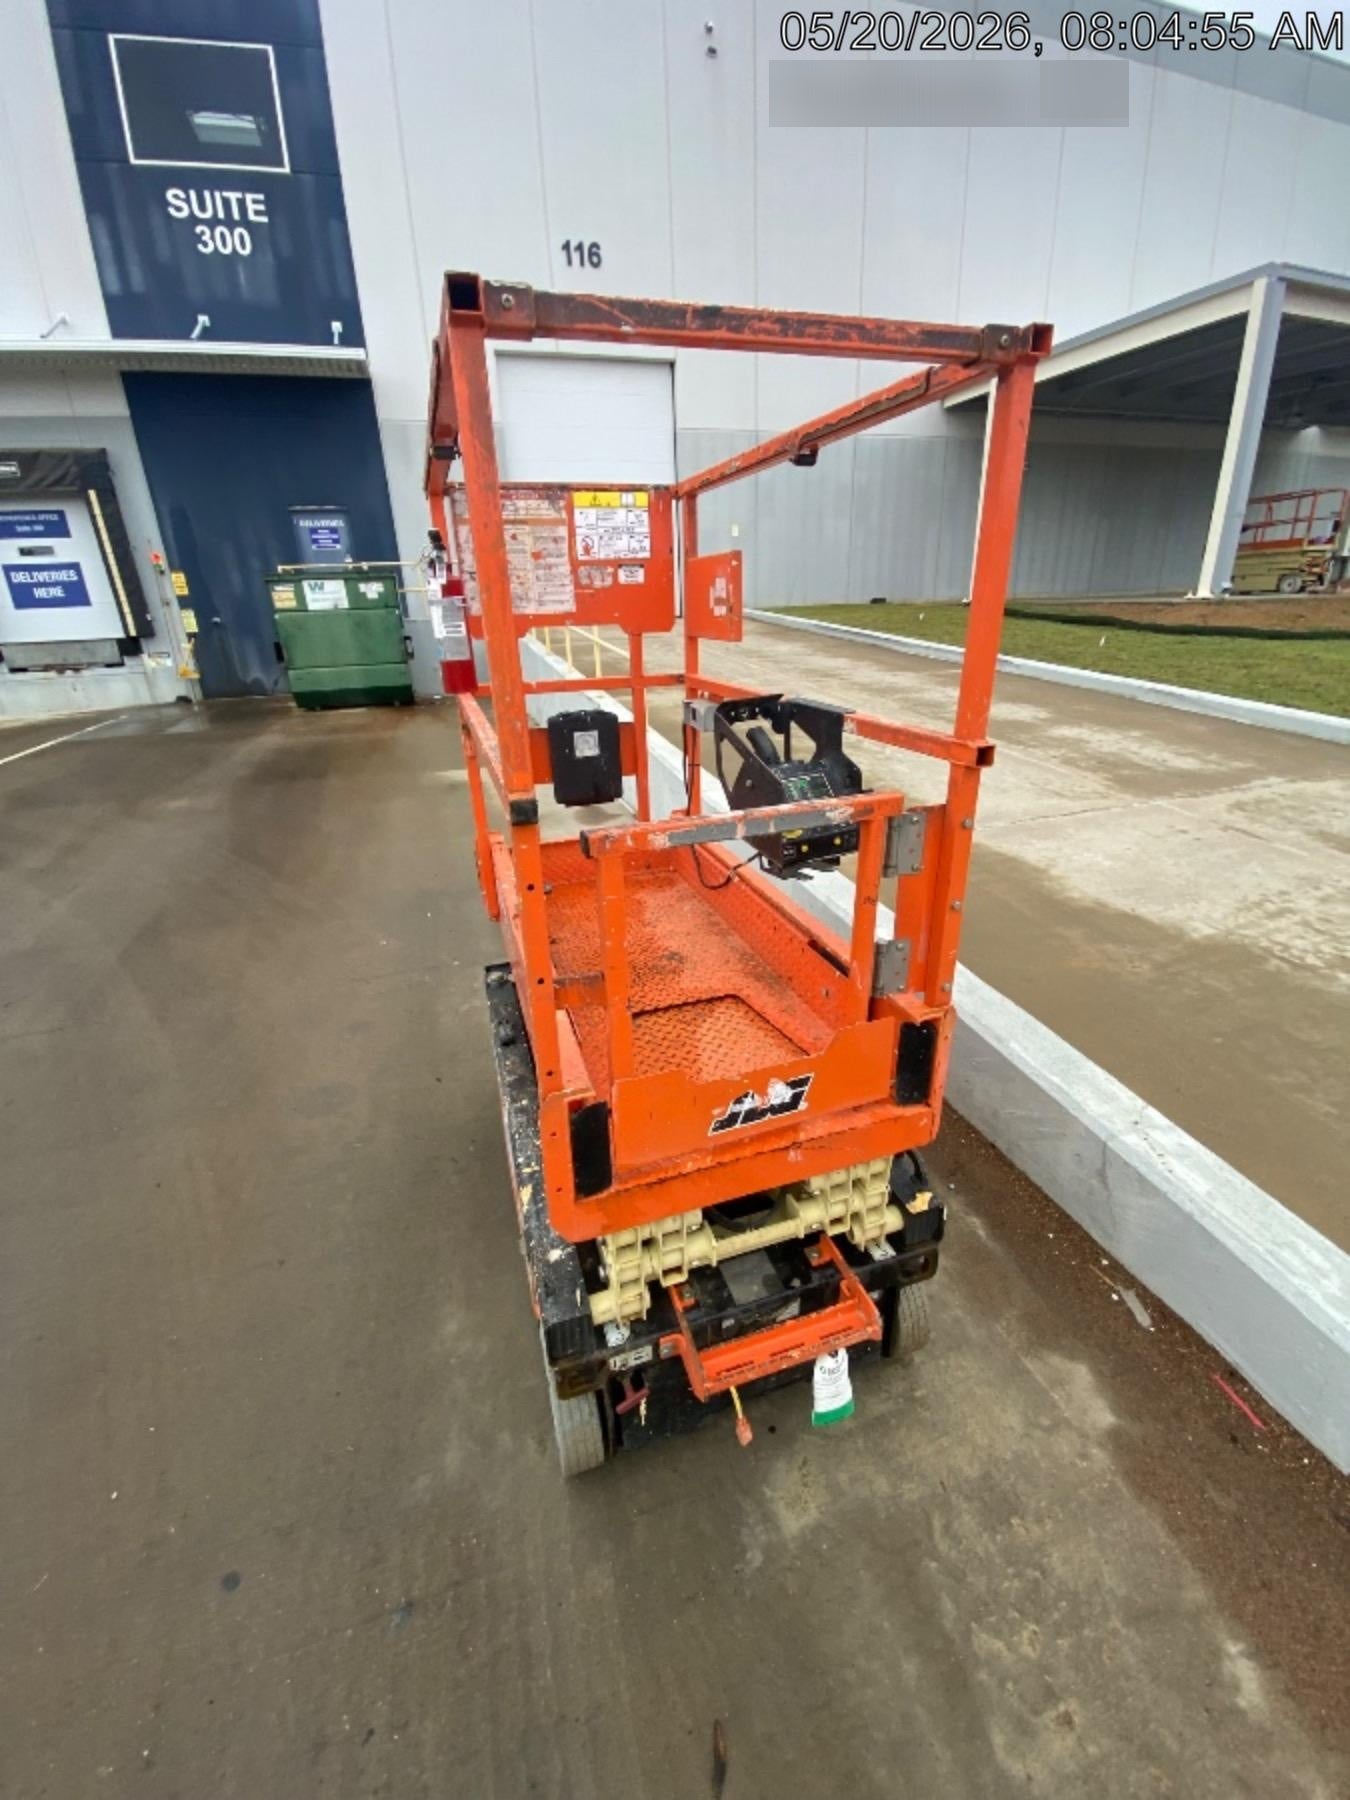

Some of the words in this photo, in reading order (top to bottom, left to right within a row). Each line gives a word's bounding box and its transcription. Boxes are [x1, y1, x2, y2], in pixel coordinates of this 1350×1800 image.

[165, 187, 269, 223] SUITE
[194, 224, 252, 256] 300
[561, 239, 602, 269] 116
[10, 569, 79, 583] DELIVERIES
[33, 585, 66, 599] HERE
